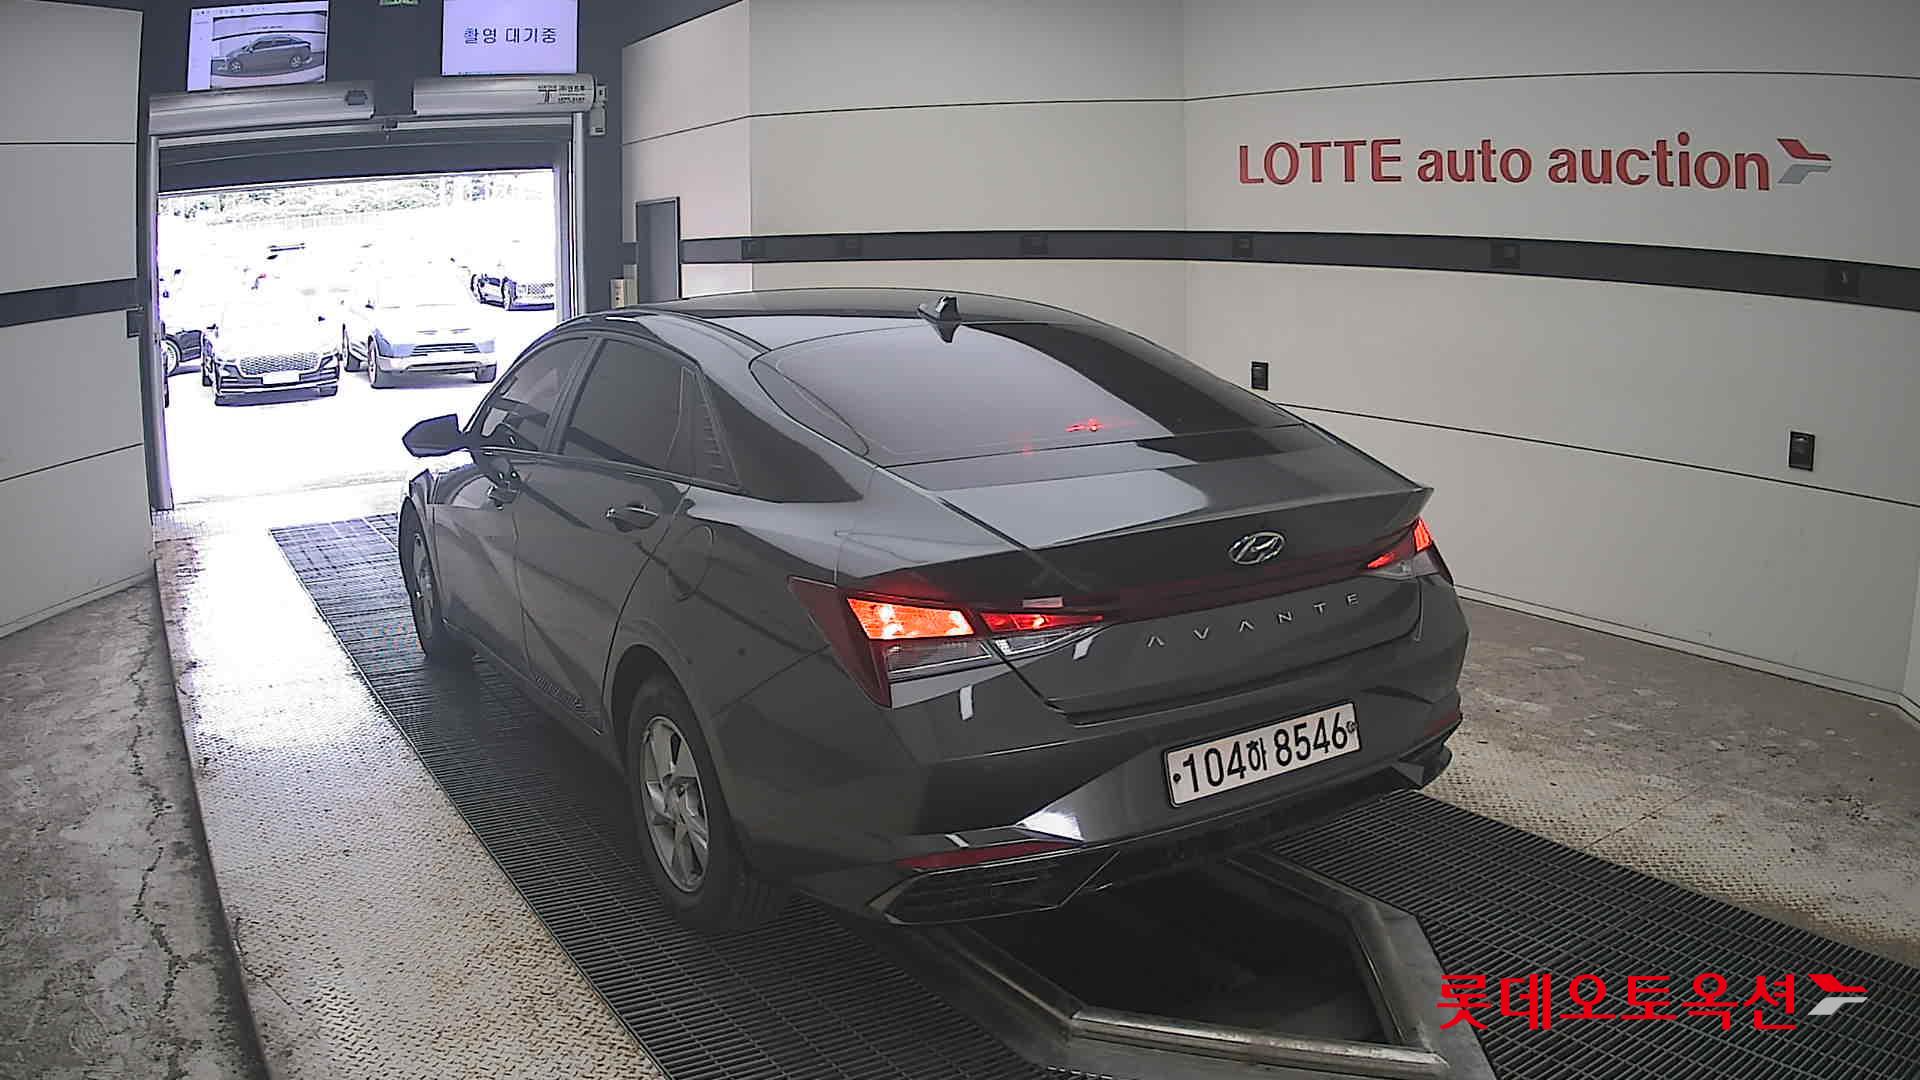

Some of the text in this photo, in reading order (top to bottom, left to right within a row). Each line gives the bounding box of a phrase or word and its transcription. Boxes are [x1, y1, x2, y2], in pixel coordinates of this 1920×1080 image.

[464, 27, 556, 44] 촬영 대기중
[1238, 131, 1771, 191] LOTTE auto auction
[1147, 593, 1359, 647] AVANTE
[1182, 711, 1349, 793] 104하 8546
